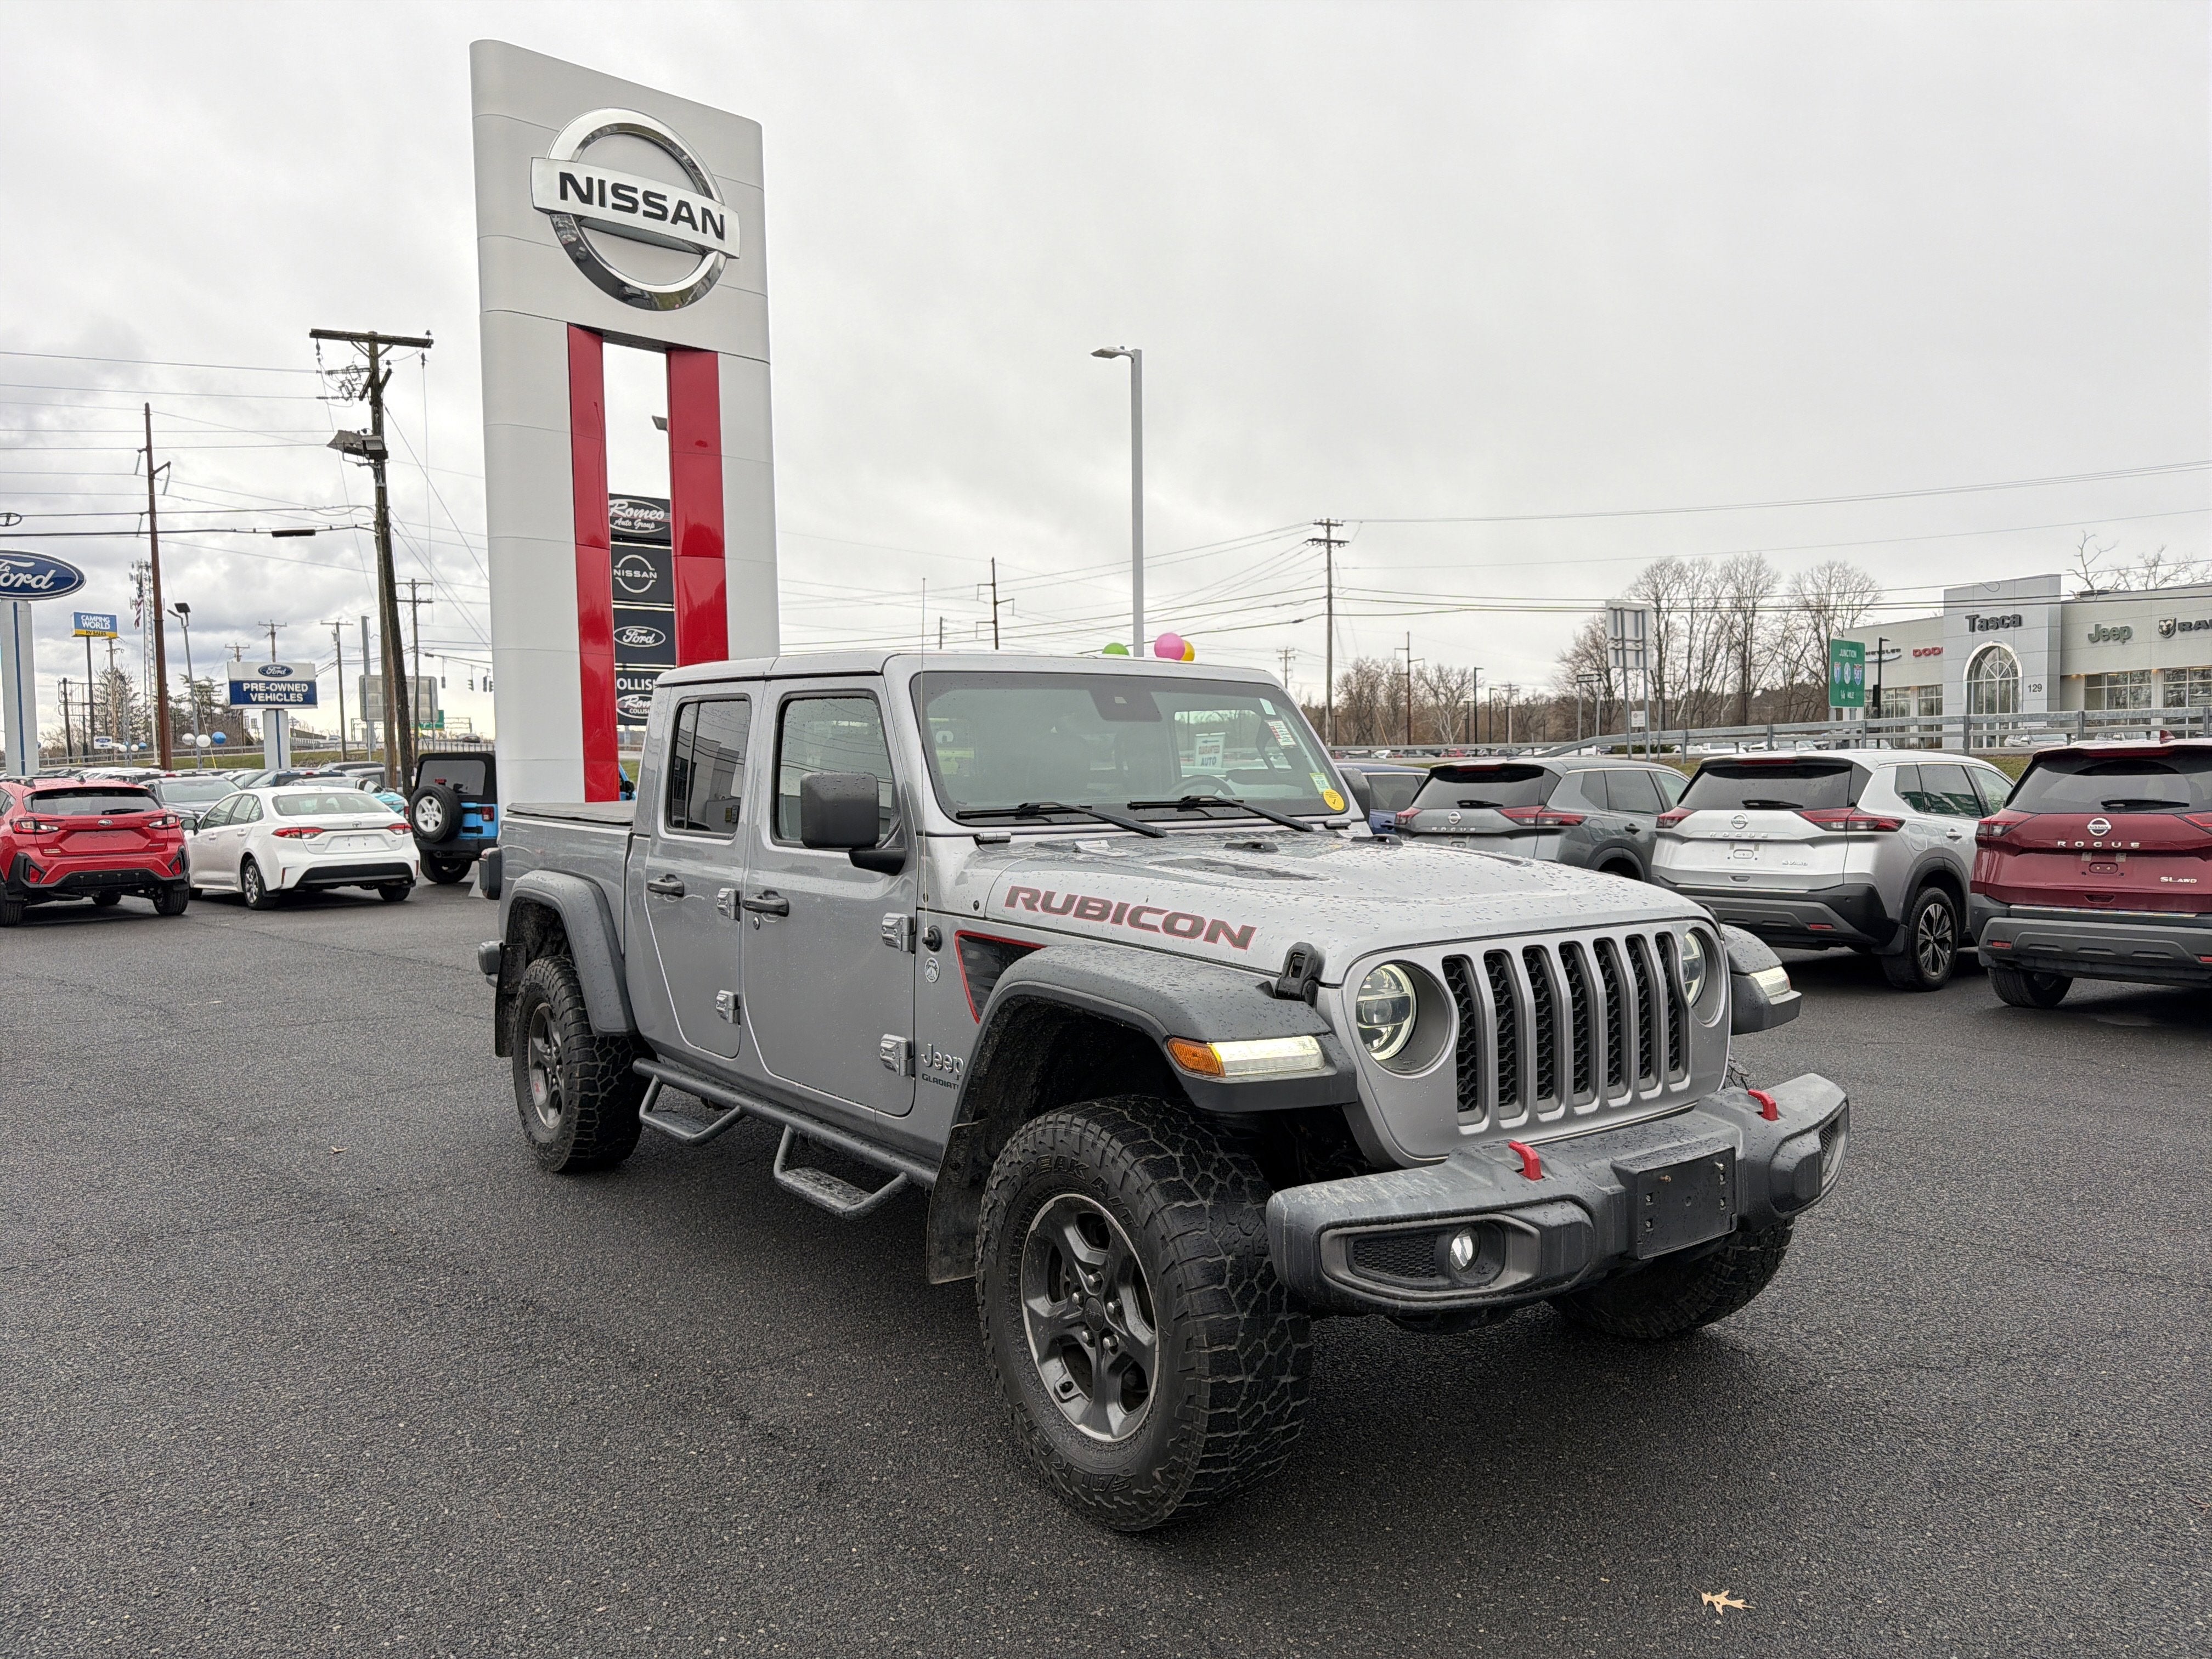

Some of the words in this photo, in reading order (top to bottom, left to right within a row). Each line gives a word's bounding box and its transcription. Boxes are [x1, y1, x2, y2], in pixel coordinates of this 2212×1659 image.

[559, 171, 725, 241] NISSAN
[609, 501, 664, 520] Romeo
[614, 517, 632, 527] Auto
[634, 518, 655, 530] Group
[613, 569, 657, 579] NISSAN
[81, 614, 110, 623] CAMPING
[81, 620, 110, 629] WORLD
[1965, 614, 2022, 633] Tasca
[2178, 619, 2212, 631] RA
[622, 628, 656, 645] Ford
[2087, 624, 2133, 645] Jeep
[1839, 648, 1857, 658] JUNCTION
[1913, 646, 1944, 657] DOD
[266, 666, 287, 675] Ford
[243, 682, 308, 692] PRE-OWNED
[617, 678, 656, 691] OLLIS
[2028, 684, 2042, 693] 129
[250, 693, 303, 702] VEHICLES
[623, 696, 652, 708] Rom
[1005, 885, 1257, 950] RUBICON
[921, 1043, 964, 1081] Jeep
[922, 1073, 959, 1090] GLADIAT
